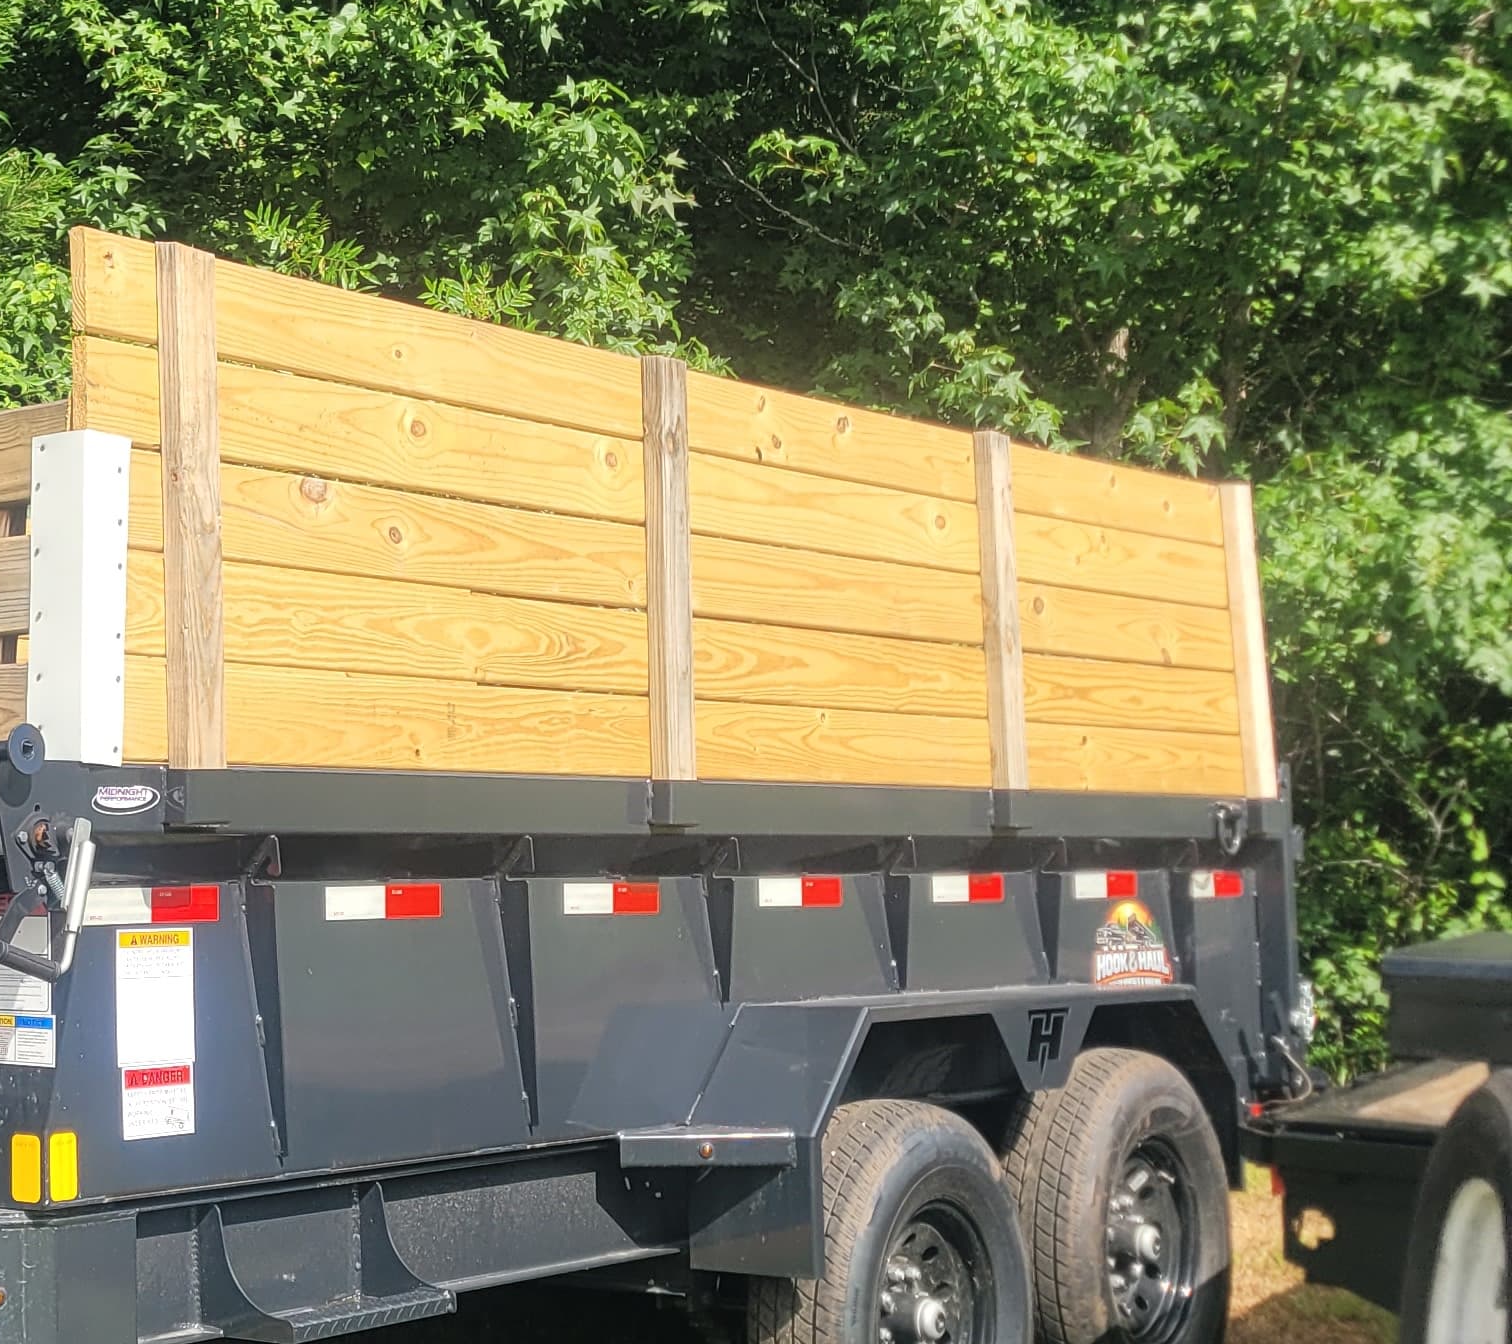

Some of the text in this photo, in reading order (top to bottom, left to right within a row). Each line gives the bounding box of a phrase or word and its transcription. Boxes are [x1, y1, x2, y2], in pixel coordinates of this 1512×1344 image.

[98, 787, 148, 796] MIDNIGHT
[139, 934, 180, 945] WARNING
[1095, 950, 1170, 981] HOOK & HAUL
[141, 1070, 184, 1086] DANGER
